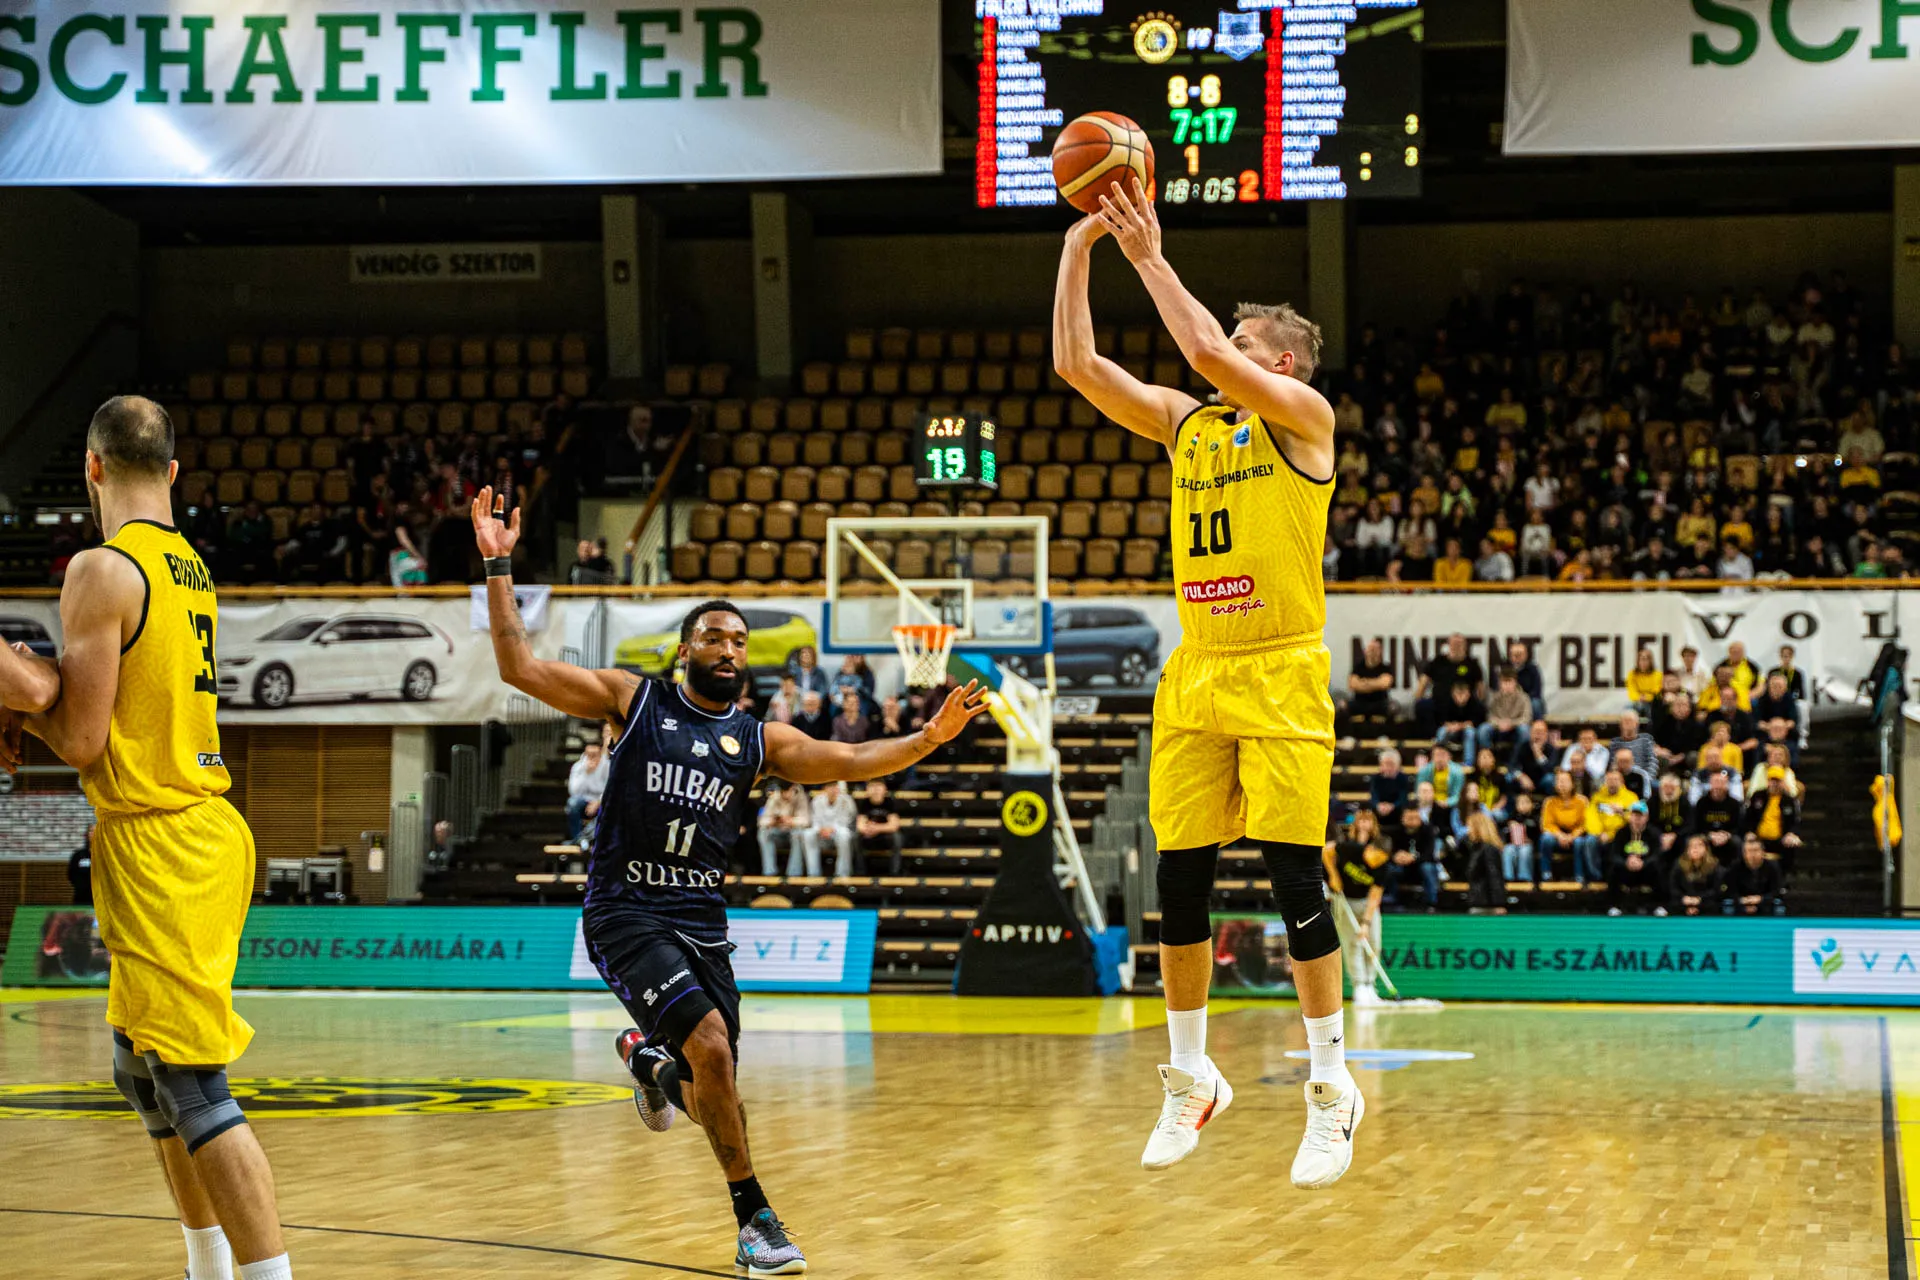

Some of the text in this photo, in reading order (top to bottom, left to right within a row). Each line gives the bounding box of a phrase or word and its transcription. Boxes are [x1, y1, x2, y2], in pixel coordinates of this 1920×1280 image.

[0, 8, 769, 106] SCHAEFFLER
[1169, 107, 1238, 145] 7:17
[1183, 144, 1200, 177] 1
[1164, 176, 1237, 204] 18:05
[1238, 169, 1260, 203] 2
[356, 250, 536, 276] VENDÉG SZEKTOR
[925, 446, 966, 481] 19
[1189, 508, 1232, 557] 10
[1182, 578, 1251, 600] VULCANO
[1210, 597, 1265, 618] energia
[188, 609, 218, 694] 3
[646, 761, 735, 812] BILBAO
[664, 817, 698, 858] 11
[626, 860, 721, 888] surne
[330, 933, 507, 960] E-SZÁMLÁRA
[983, 924, 1063, 944] APTIV
[1381, 942, 1516, 971] VÁLTSON
[1527, 943, 1720, 973] E-SZÁMLÁRA
